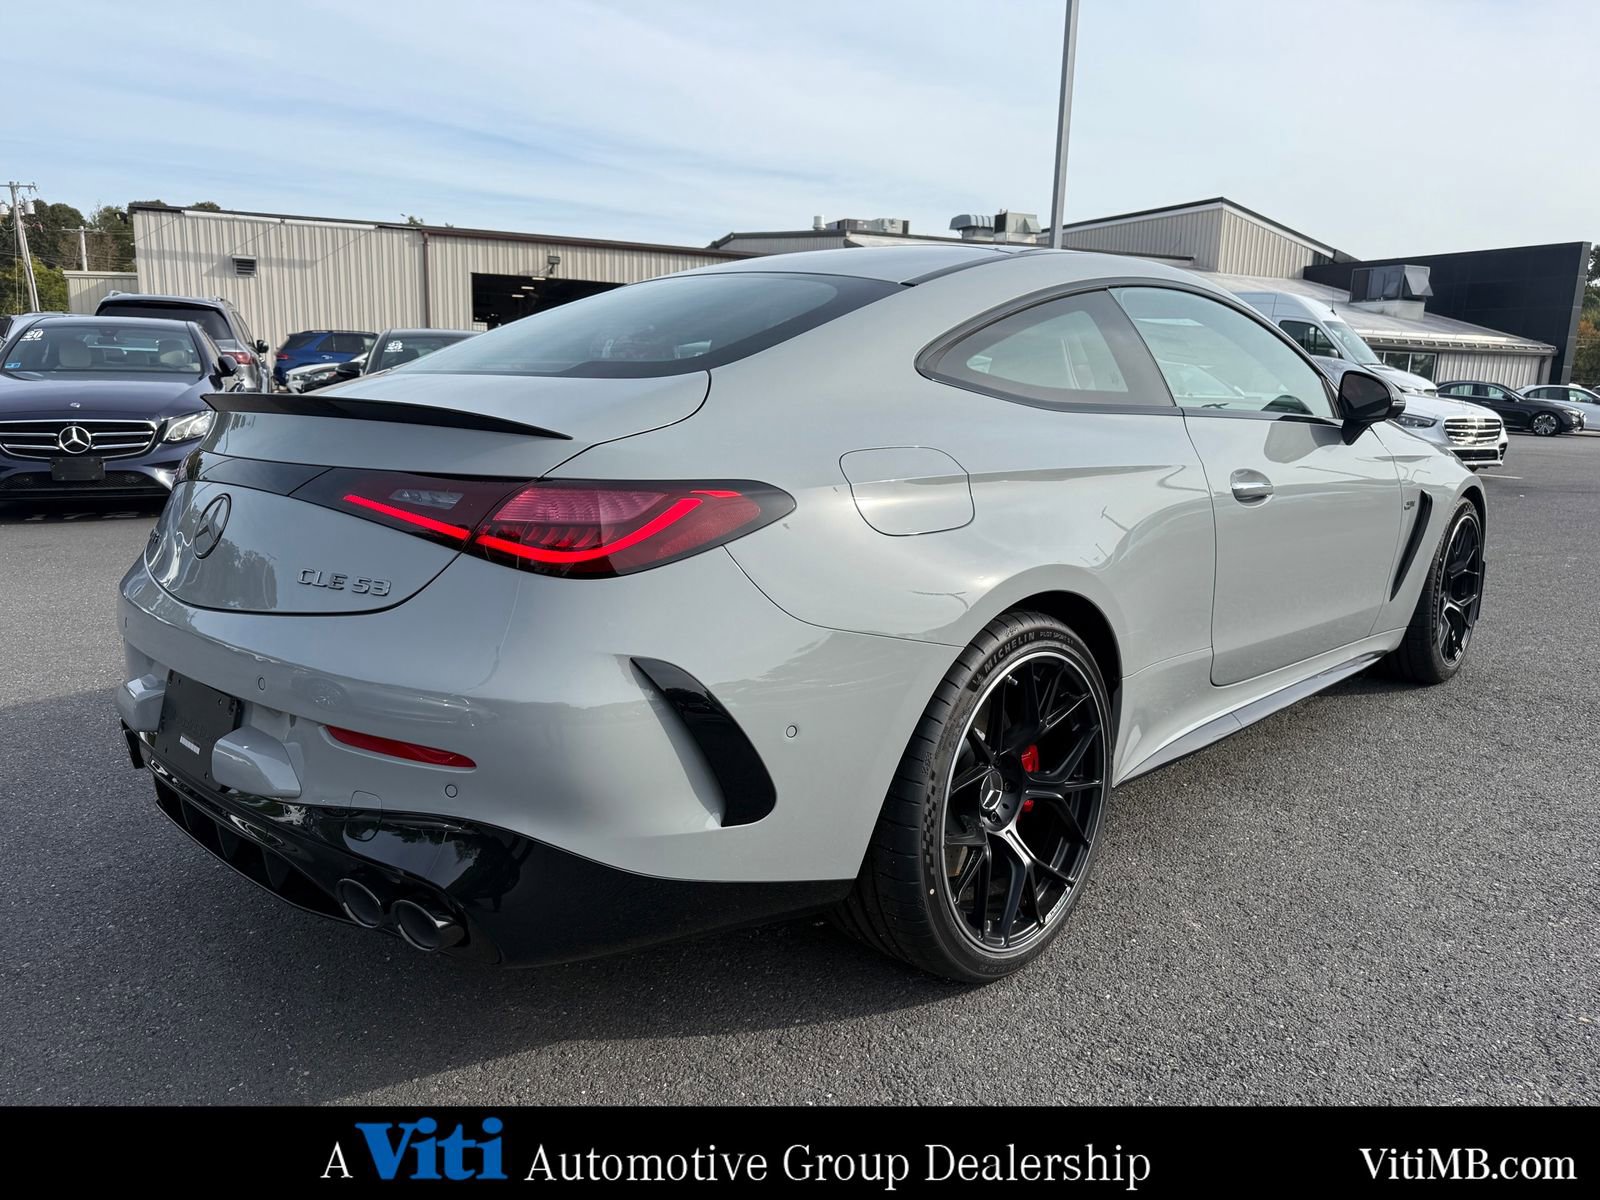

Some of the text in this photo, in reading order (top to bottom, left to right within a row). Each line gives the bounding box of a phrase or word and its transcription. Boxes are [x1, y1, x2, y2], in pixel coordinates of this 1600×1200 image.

[297, 567, 391, 597] CLE 53
[984, 631, 1036, 673] MICHELIN
